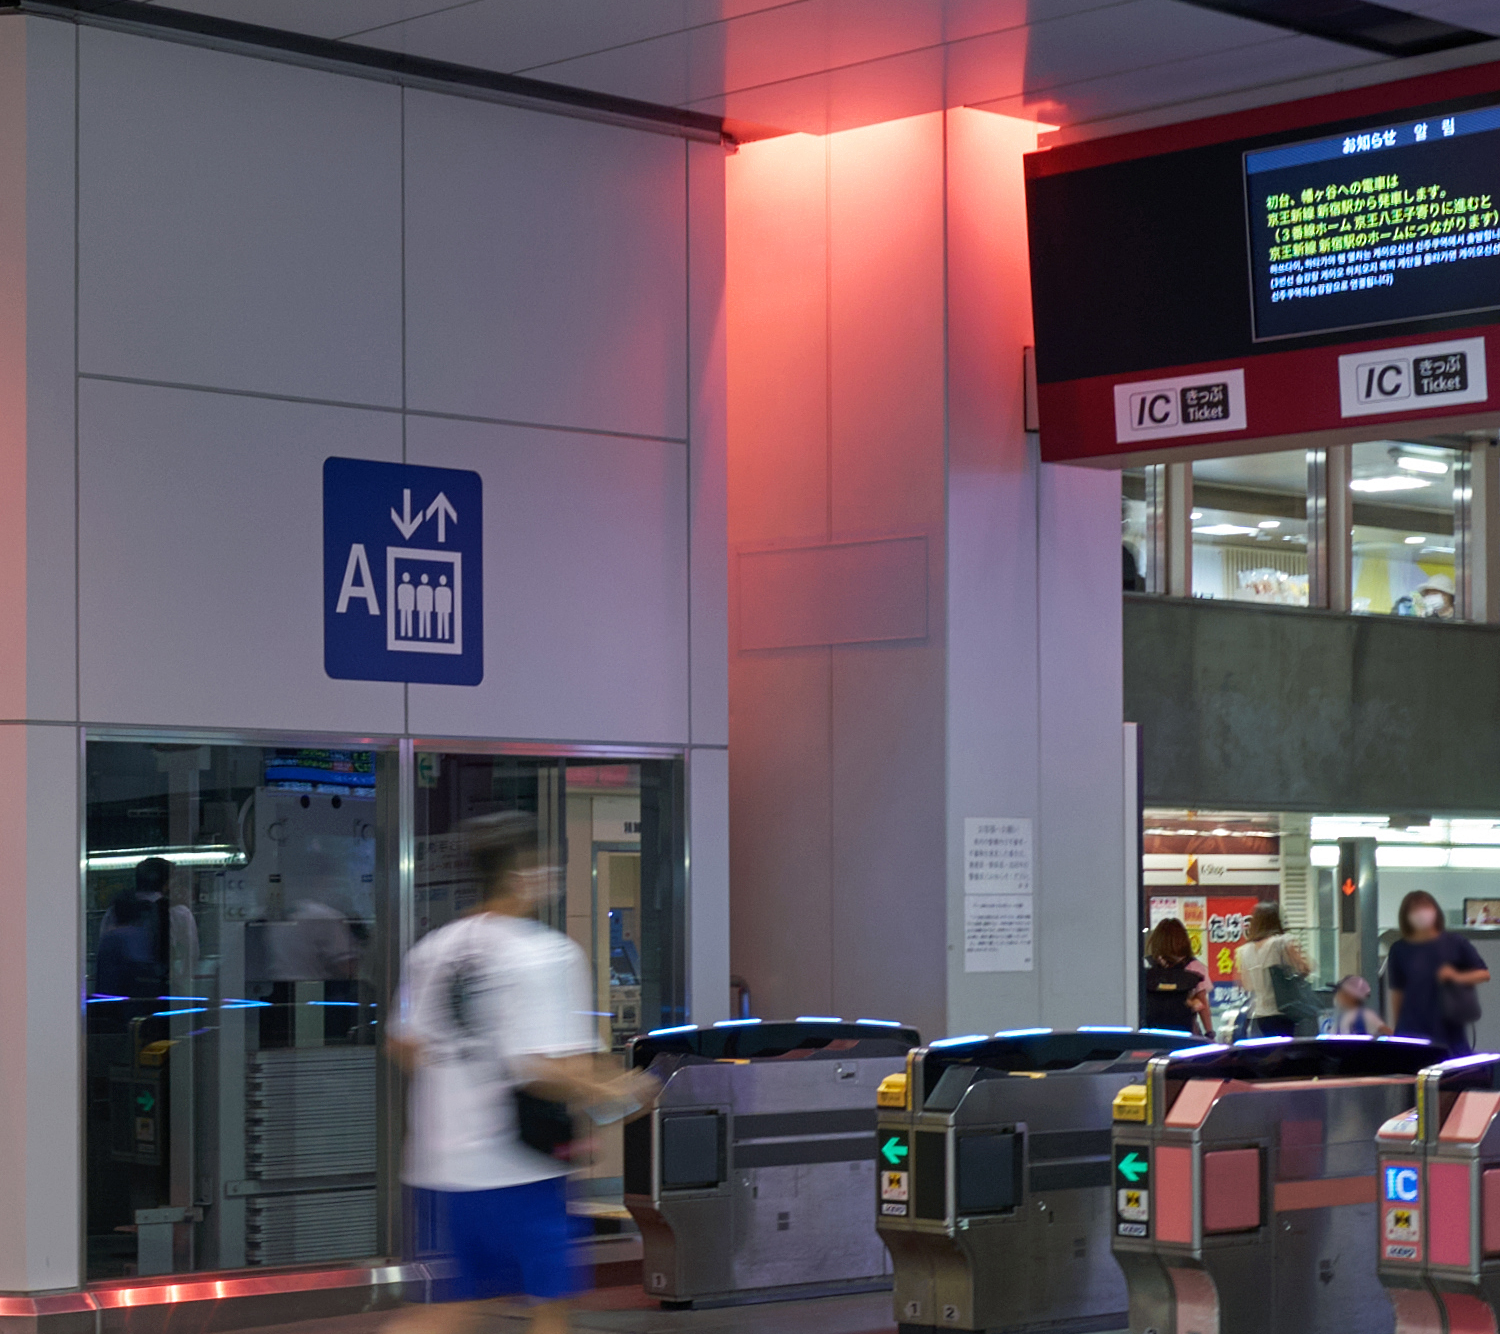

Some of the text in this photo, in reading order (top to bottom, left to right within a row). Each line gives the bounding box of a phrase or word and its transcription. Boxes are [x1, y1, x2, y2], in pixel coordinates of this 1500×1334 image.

[1342, 129, 1397, 155] お知らせ
[1418, 354, 1462, 375] きっぷ
[1363, 364, 1404, 398] IC
[1419, 373, 1462, 395] Ticket
[1185, 386, 1224, 405] きっぷ
[1136, 394, 1173, 427] IC
[1187, 402, 1224, 420] Ticket
[336, 543, 381, 616] A
[1386, 1167, 1418, 1202] IC
